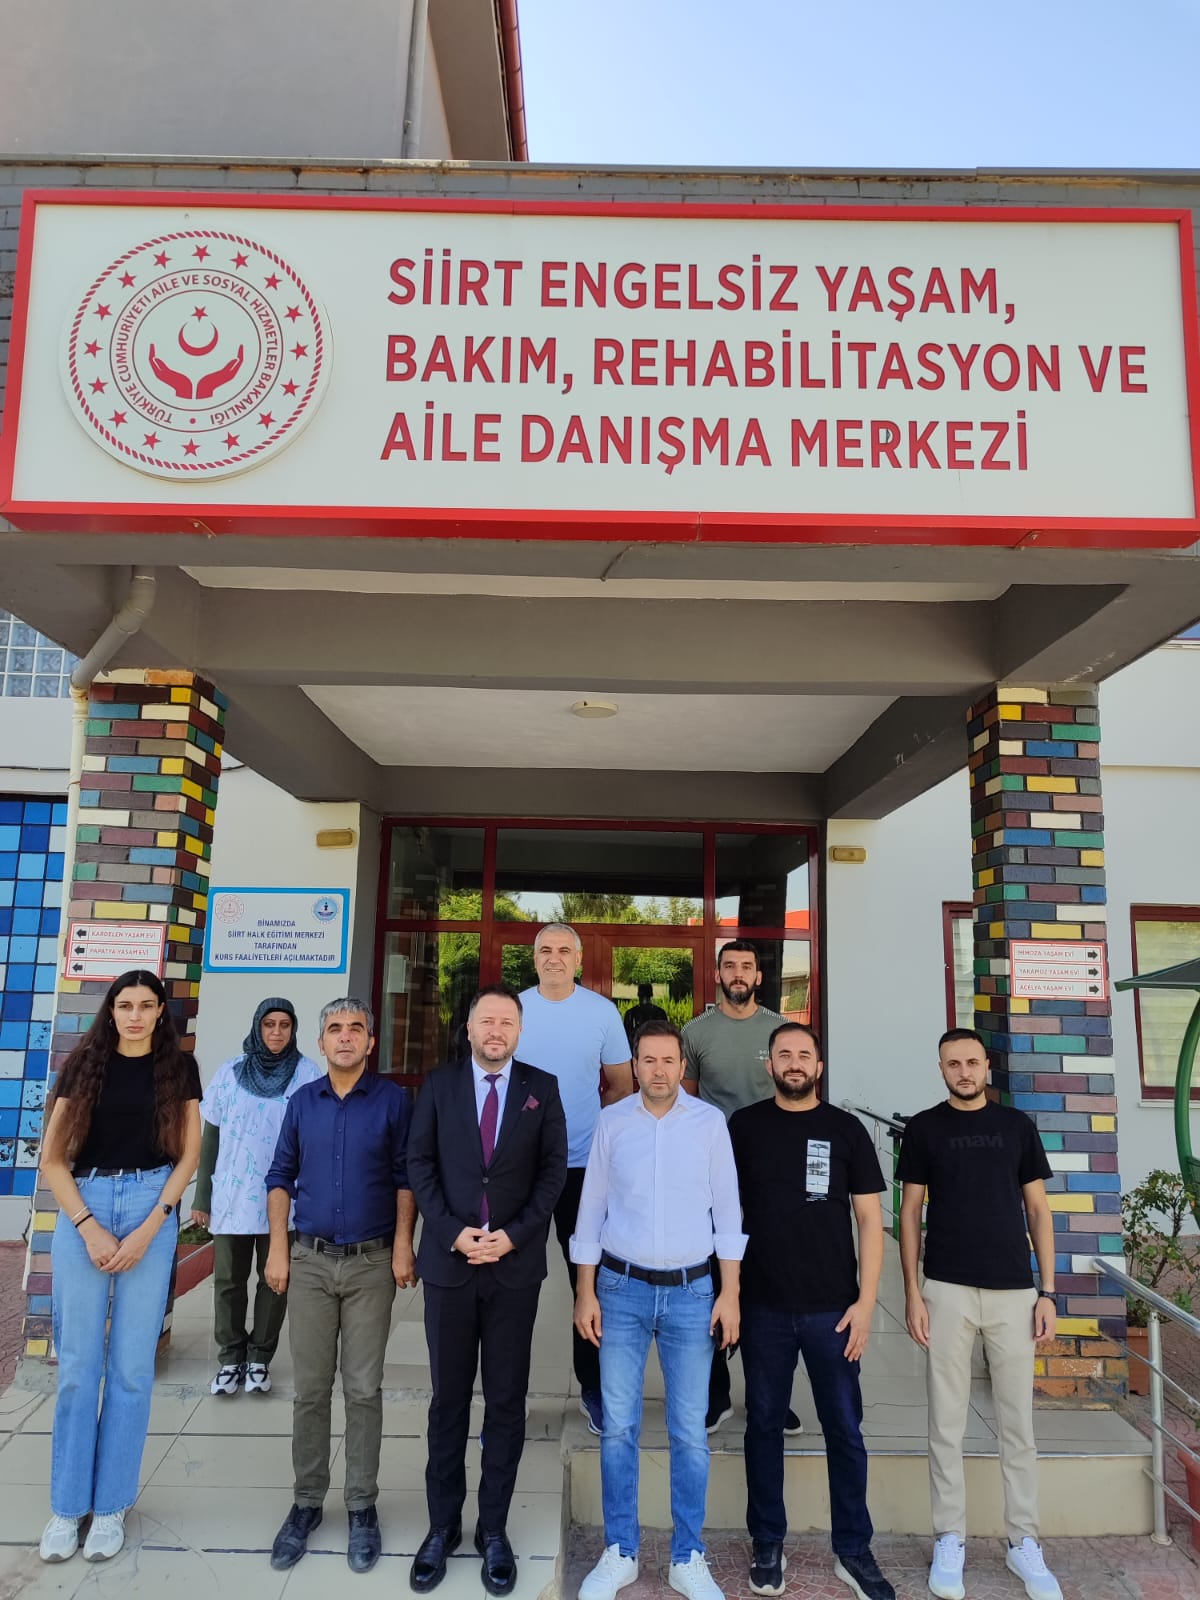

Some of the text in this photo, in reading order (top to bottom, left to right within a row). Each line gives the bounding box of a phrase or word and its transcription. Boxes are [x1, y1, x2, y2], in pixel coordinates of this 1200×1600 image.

[151, 278, 180, 299] AİLE
[181, 274, 199, 286] VE
[202, 274, 249, 302] SOSYAL
[388, 248, 1015, 324] SİİRT ENGELSİZ YAŞAM,
[250, 298, 278, 371] HİZMETLER
[386, 329, 1148, 393] BAKIM, REHABİLİTASYON VE
[125, 383, 172, 424] TÜRKİYE
[210, 372, 272, 425] BAKANLIĞI
[381, 401, 1028, 475] AİLE DANIŞMA MERKEZİ
[247, 930, 265, 938] HALK
[257, 919, 296, 927] BİNAMIZDA
[214, 953, 233, 961] KURS
[254, 942, 297, 950] TARAFINDAN
[949, 1131, 1004, 1150] mavi
